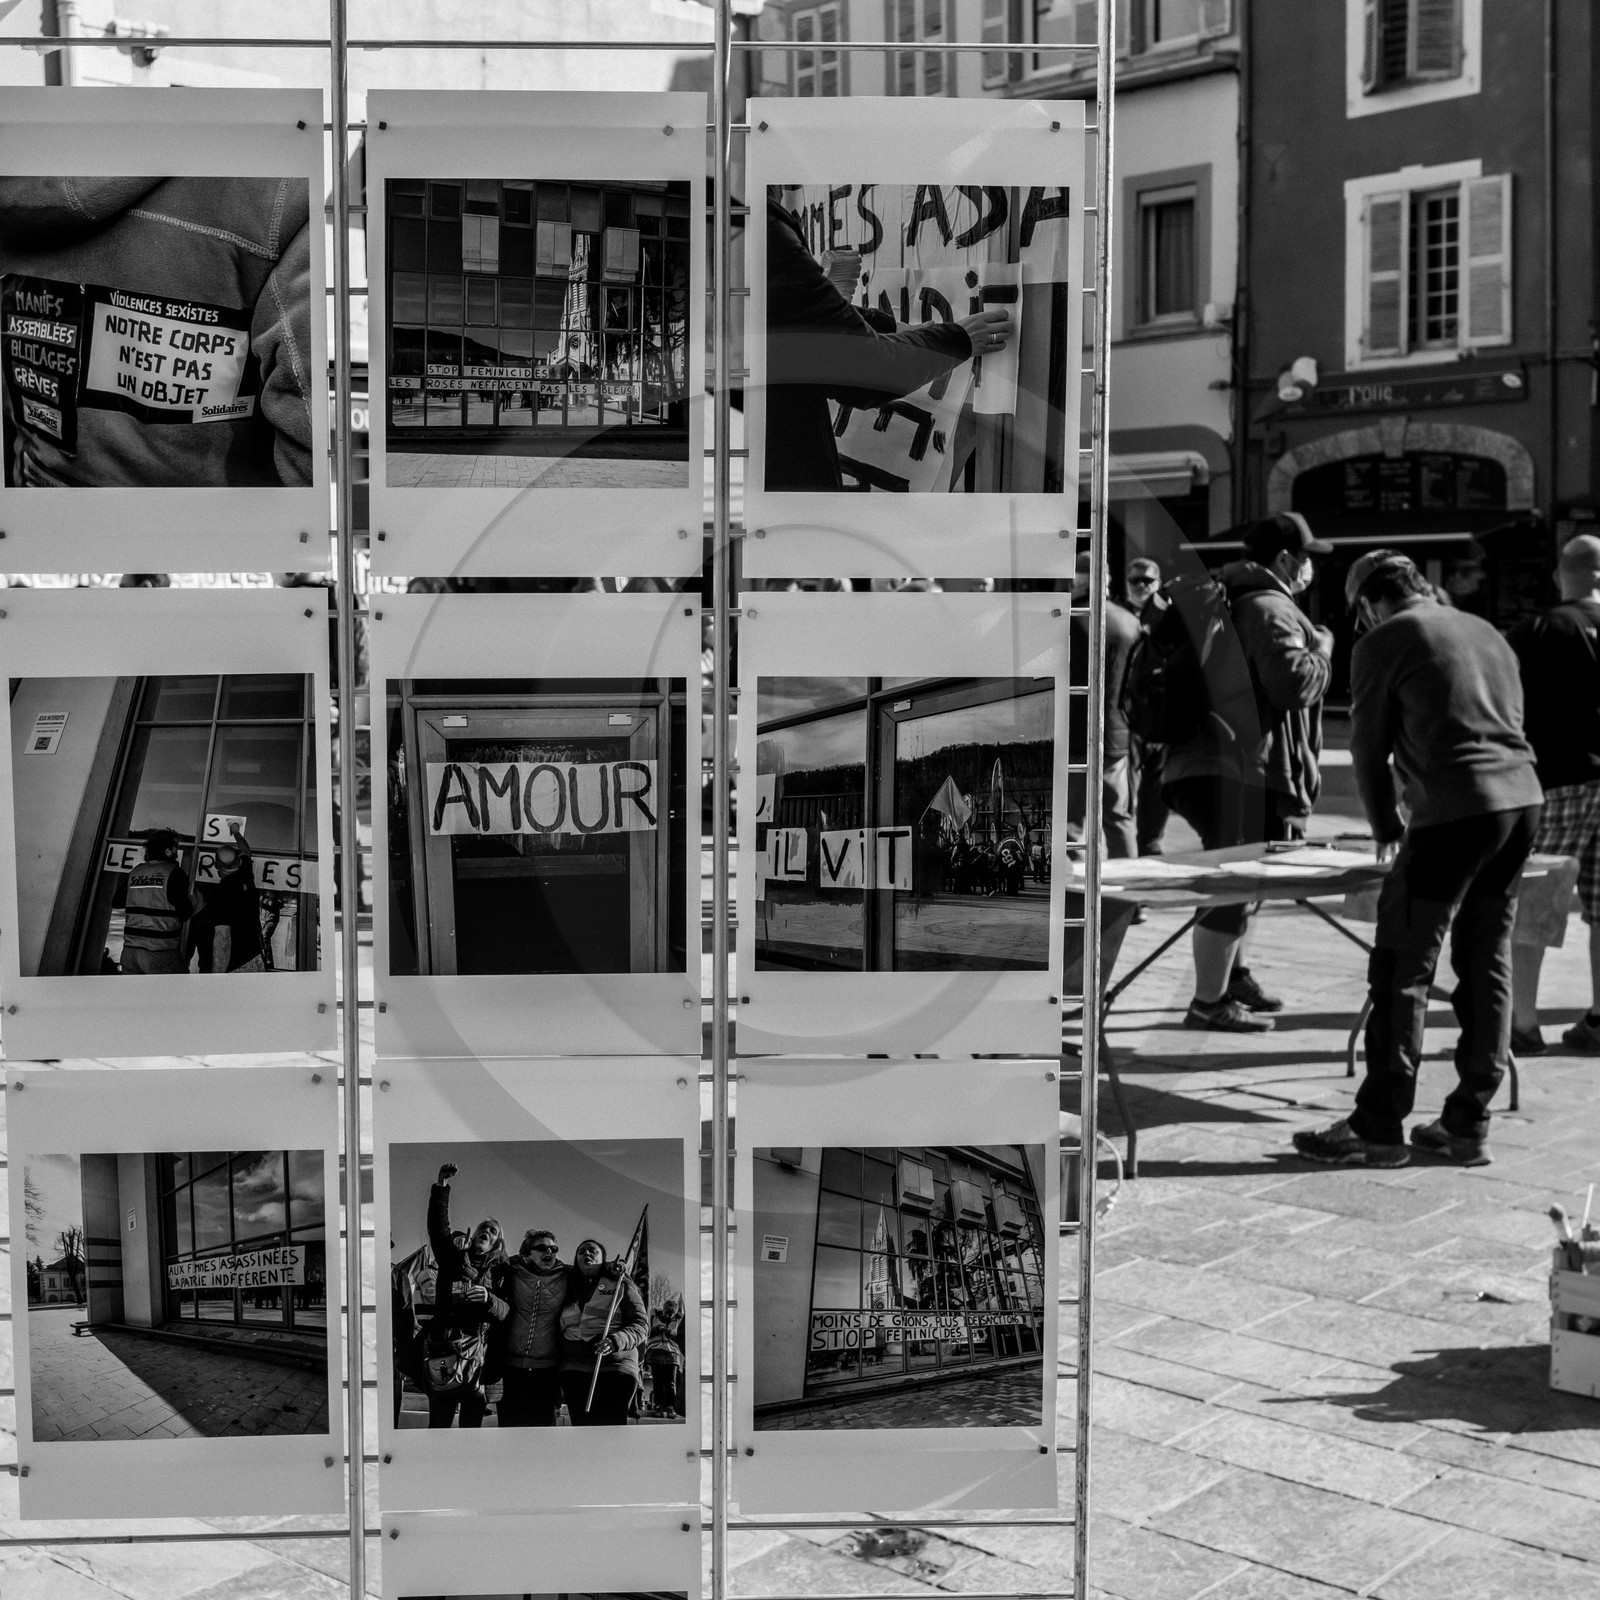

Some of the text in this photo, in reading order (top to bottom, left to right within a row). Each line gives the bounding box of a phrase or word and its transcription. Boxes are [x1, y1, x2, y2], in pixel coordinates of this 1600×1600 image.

[9, 316, 75, 344] ASSEMBLÉES
[105, 314, 237, 356] NOTRE CORPS
[11, 339, 77, 375] BLOCAGES
[119, 345, 213, 381] N'EST PAS
[428, 365, 458, 375] STOP
[14, 367, 58, 398] GRÈVES
[117, 372, 210, 405] UN OBJET
[389, 379, 411, 388] LES
[427, 379, 463, 389] ROSES
[540, 384, 560, 393] PAS
[569, 384, 587, 393] LES
[601, 385, 632, 395] BLEUS
[201, 403, 249, 416] Solidaires
[432, 761, 657, 834] AMOUR
[168, 1265, 185, 1276] AUX
[812, 1314, 861, 1329] MOINS
[869, 1315, 885, 1328] DE
[936, 1316, 959, 1327] PLUS
[967, 1316, 978, 1326] DE
[812, 1329, 875, 1350] STOP
